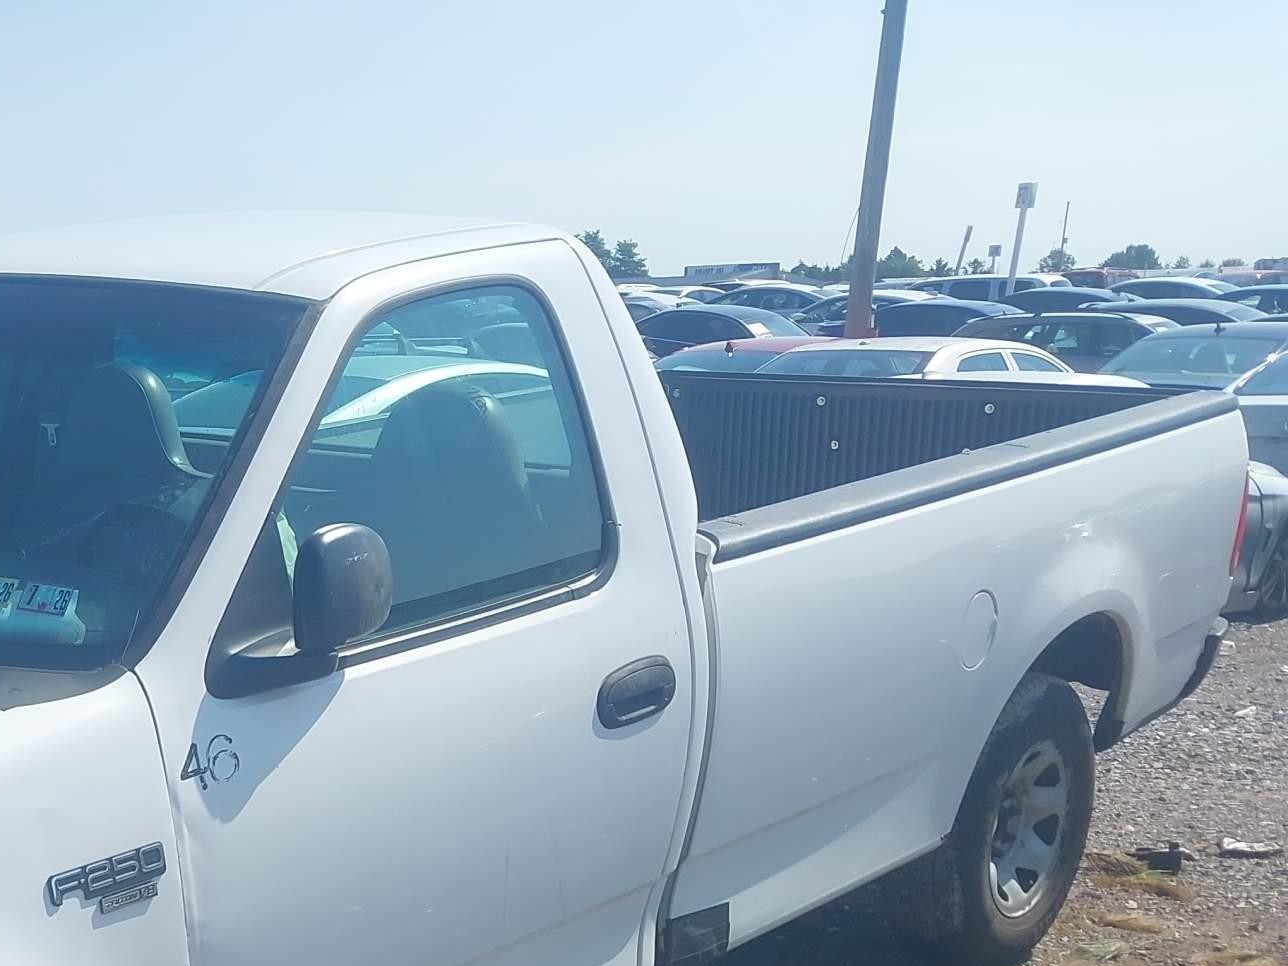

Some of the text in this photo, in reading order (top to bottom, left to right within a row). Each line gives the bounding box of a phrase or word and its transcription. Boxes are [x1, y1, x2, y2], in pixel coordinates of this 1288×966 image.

[27, 584, 71, 611] 7 26
[180, 733, 240, 792] 46
